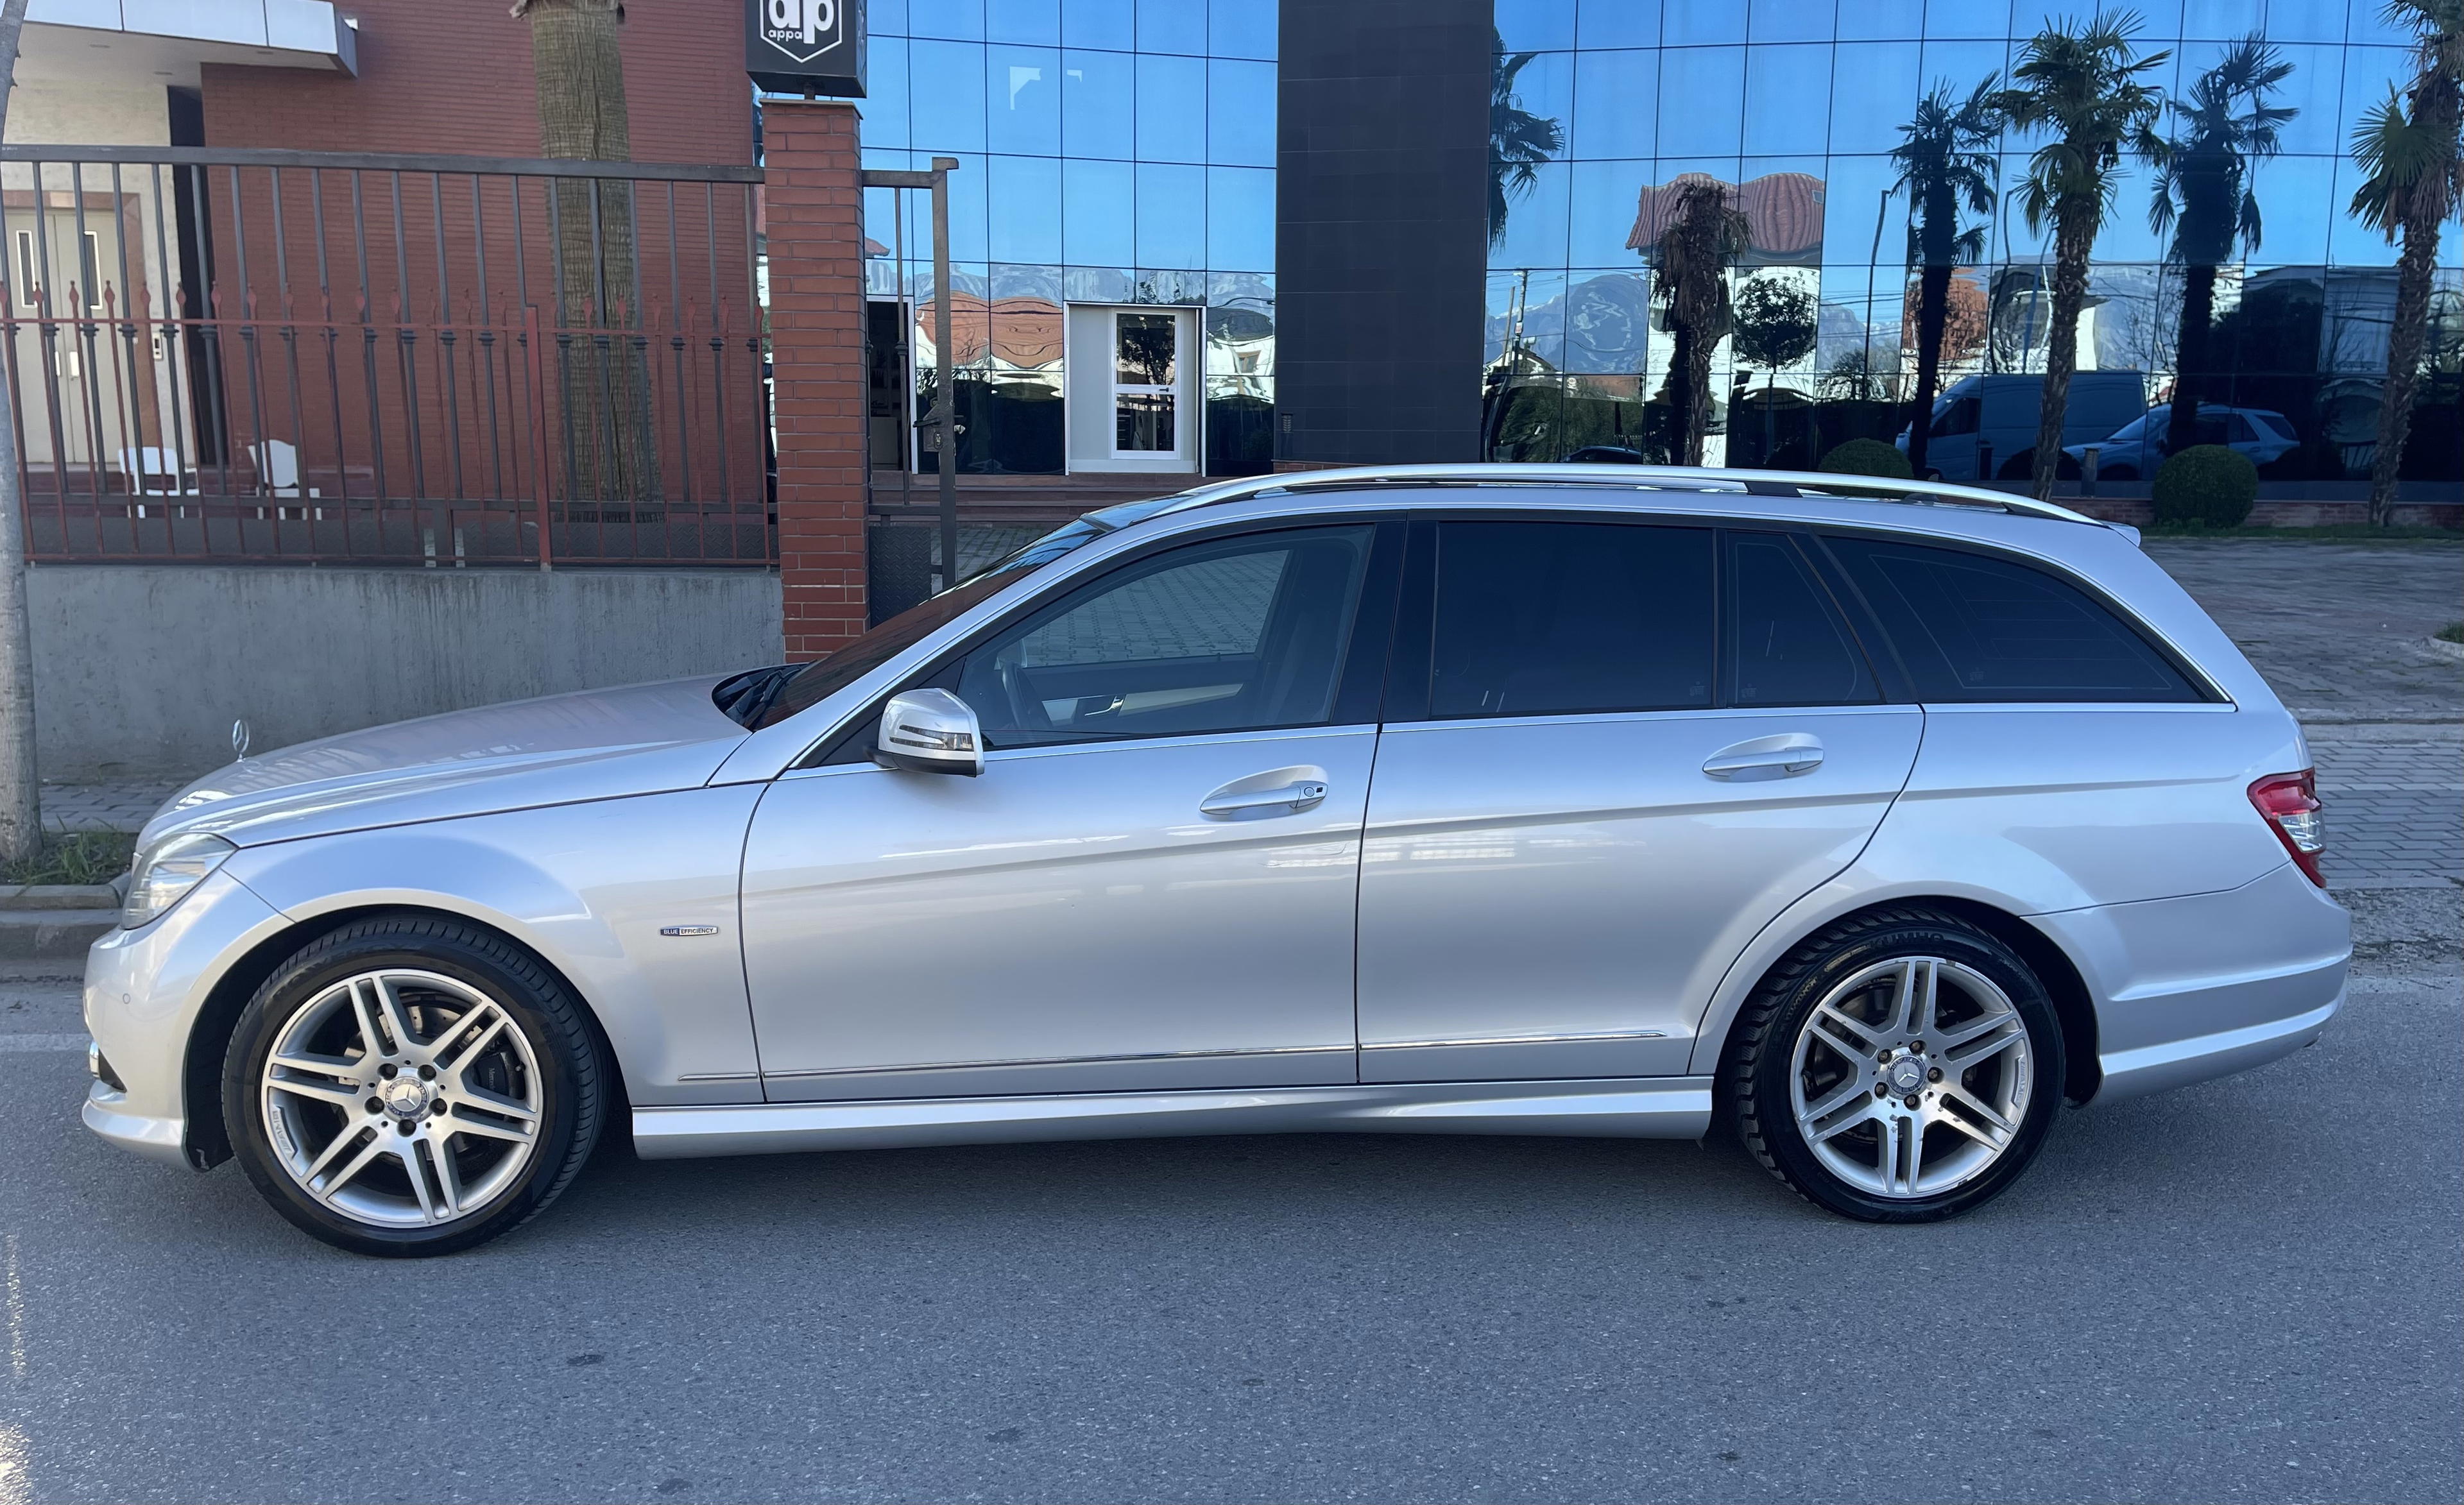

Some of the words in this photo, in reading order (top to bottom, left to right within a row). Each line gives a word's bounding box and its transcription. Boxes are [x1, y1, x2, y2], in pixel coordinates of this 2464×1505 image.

[768, 0, 834, 44] ap
[768, 29, 802, 42] appa
[1870, 932, 1944, 948] KUMHO
